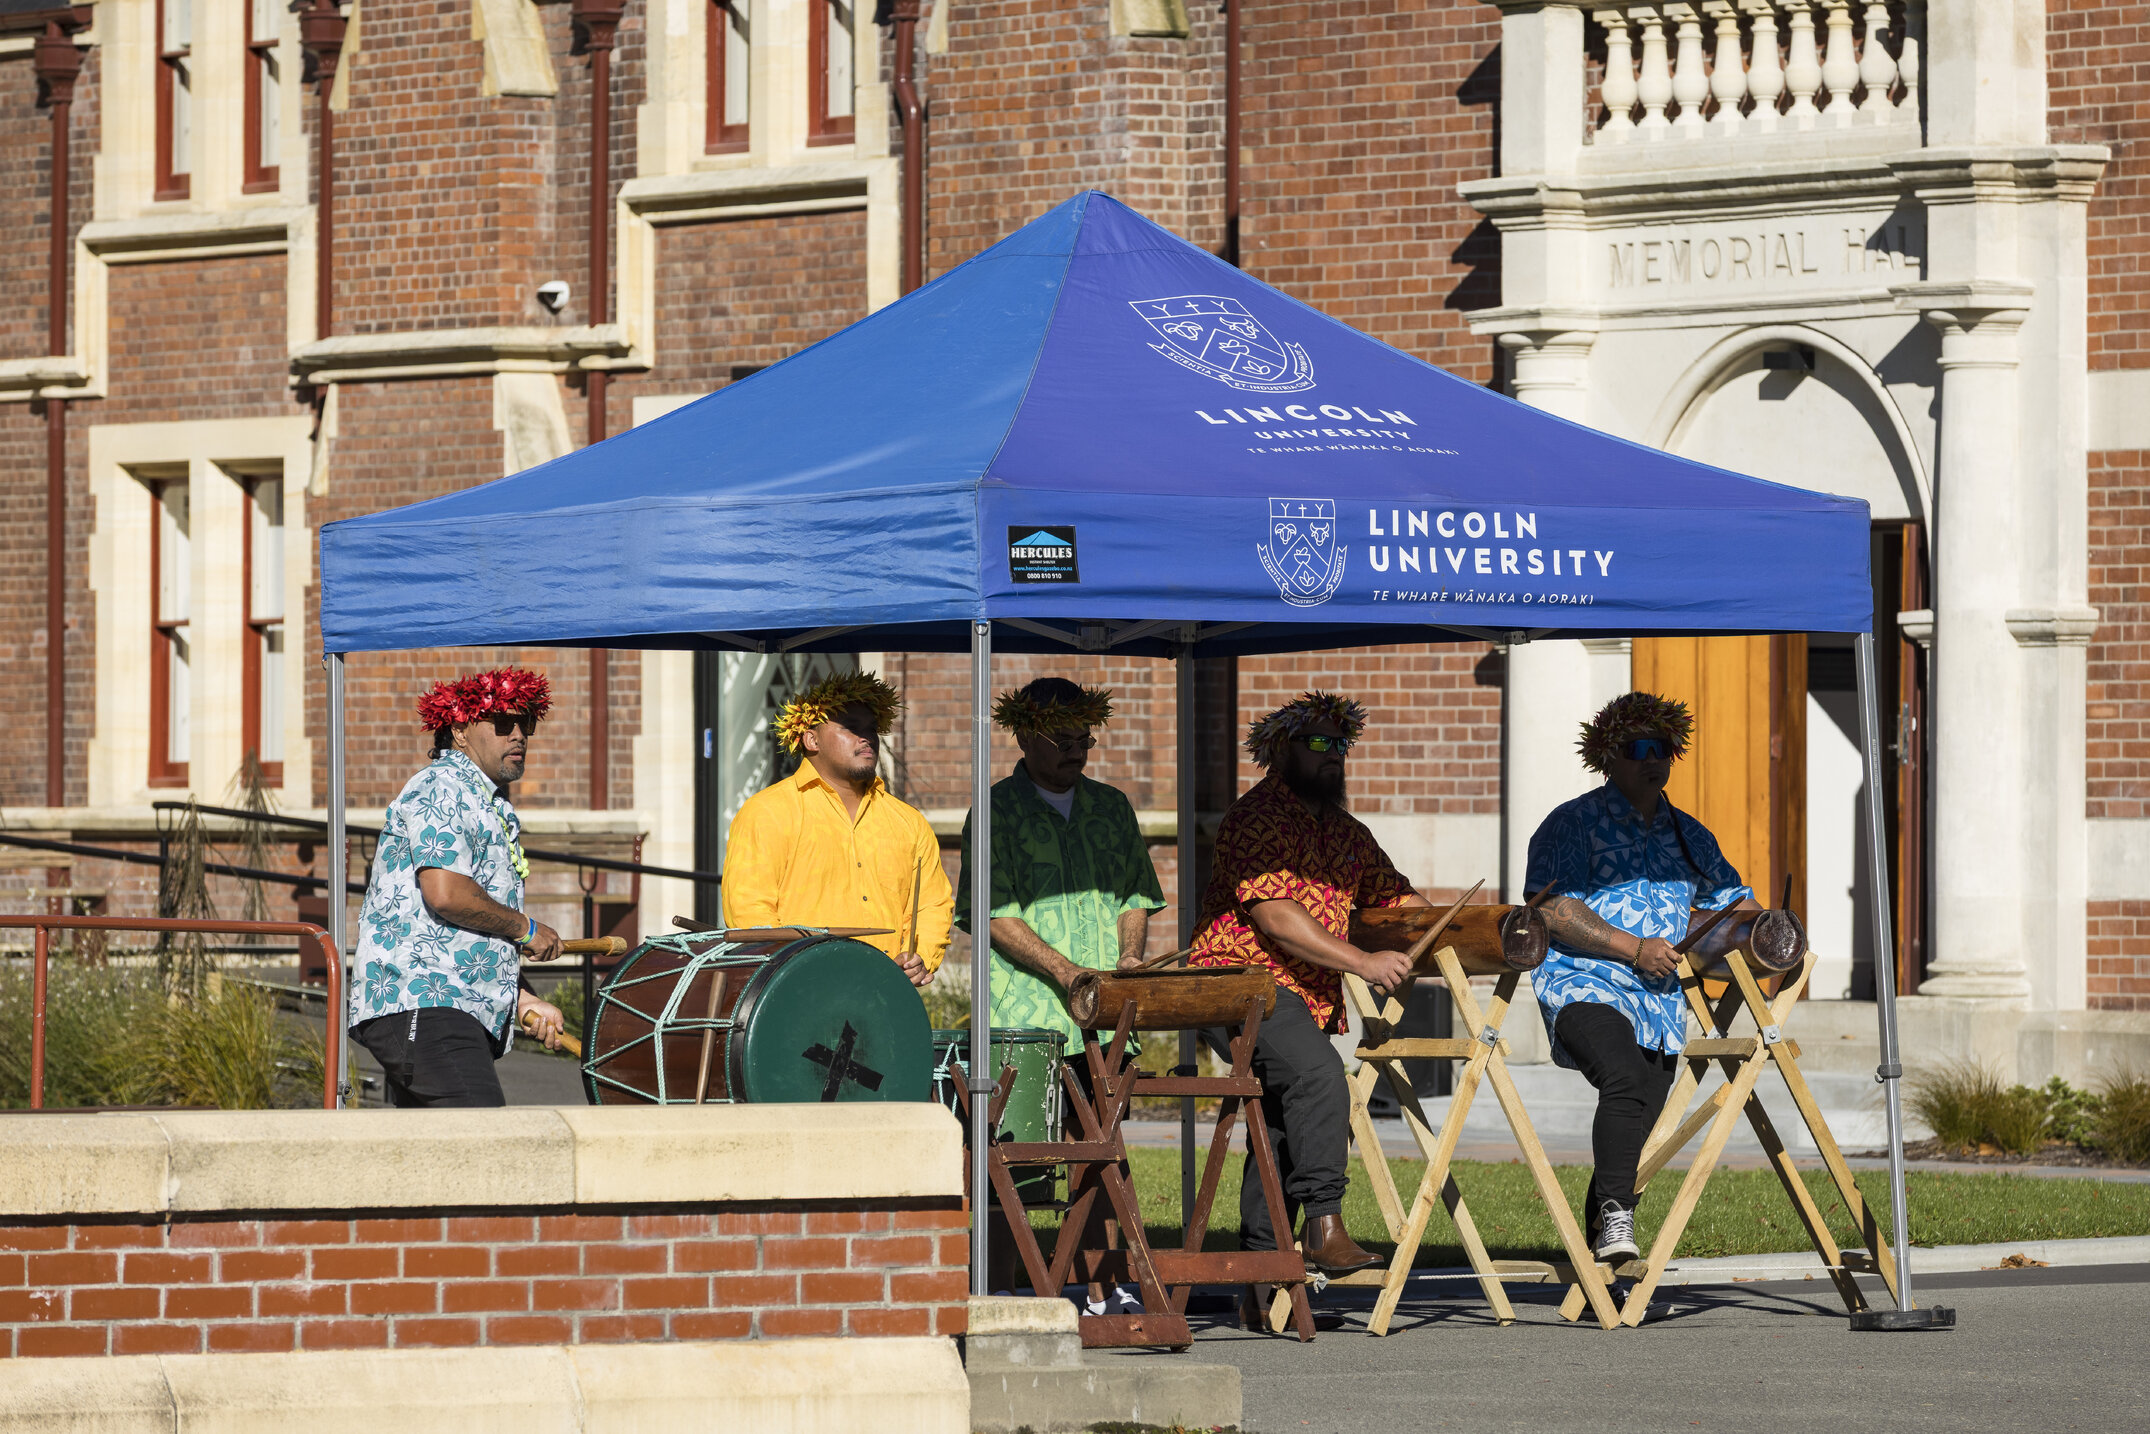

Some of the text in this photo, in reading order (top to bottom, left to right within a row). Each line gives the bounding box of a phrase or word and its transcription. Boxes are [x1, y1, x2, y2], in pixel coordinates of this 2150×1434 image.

[1609, 225, 1928, 288] MEMORIAL HAL
[1167, 351, 1211, 375] SCIENTIA
[1194, 404, 1418, 426] LINCOLN
[1254, 428, 1411, 440] UNIVERSITY
[1269, 445, 1324, 454] WHARE
[1326, 443, 1390, 451] WĀNAKA
[1407, 446, 1460, 455] AORAKI
[1369, 509, 1537, 539] LINCOLN
[1011, 547, 1073, 559] HERCULES
[1369, 545, 1614, 577] UNIVERSITY
[1262, 555, 1281, 582] SCIENTIA
[1332, 555, 1343, 583] PROBITATE
[1373, 589, 1594, 605] TE WHARE WĀNAKA O AORAKI
